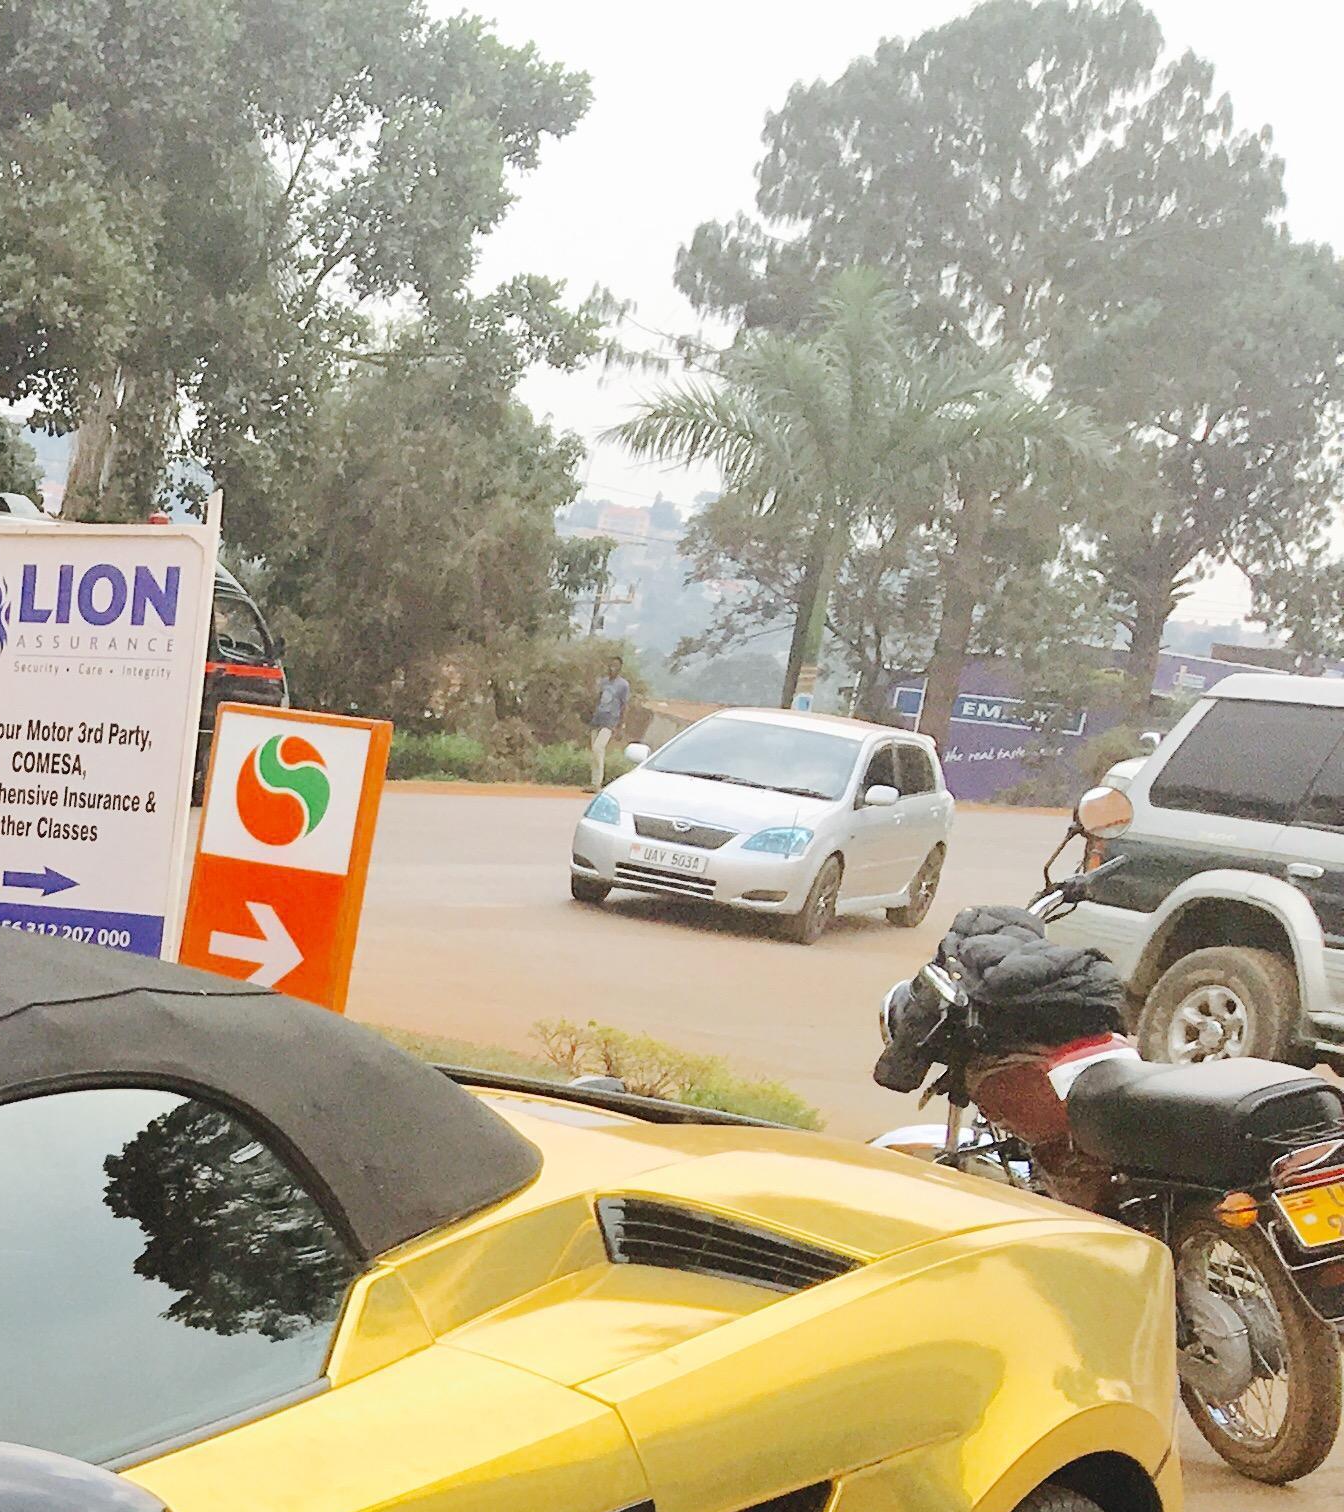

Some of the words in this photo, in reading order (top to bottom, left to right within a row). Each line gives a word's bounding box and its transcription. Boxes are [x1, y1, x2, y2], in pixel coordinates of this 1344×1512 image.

[18, 563, 181, 627] LION
[16, 634, 175, 653] ASSURANCE
[13, 660, 60, 676] Security
[78, 663, 103, 676] Care
[122, 664, 172, 681] Integrity
[26, 719, 74, 742] Motor
[77, 721, 104, 744] 3rd
[108, 723, 153, 752] Party,
[11, 750, 88, 780] COMESA,
[62, 786, 141, 812] Insurance
[145, 790, 157, 814] &
[36, 816, 99, 842] Classes
[62, 925, 95, 944] 207
[97, 928, 131, 948] 000
